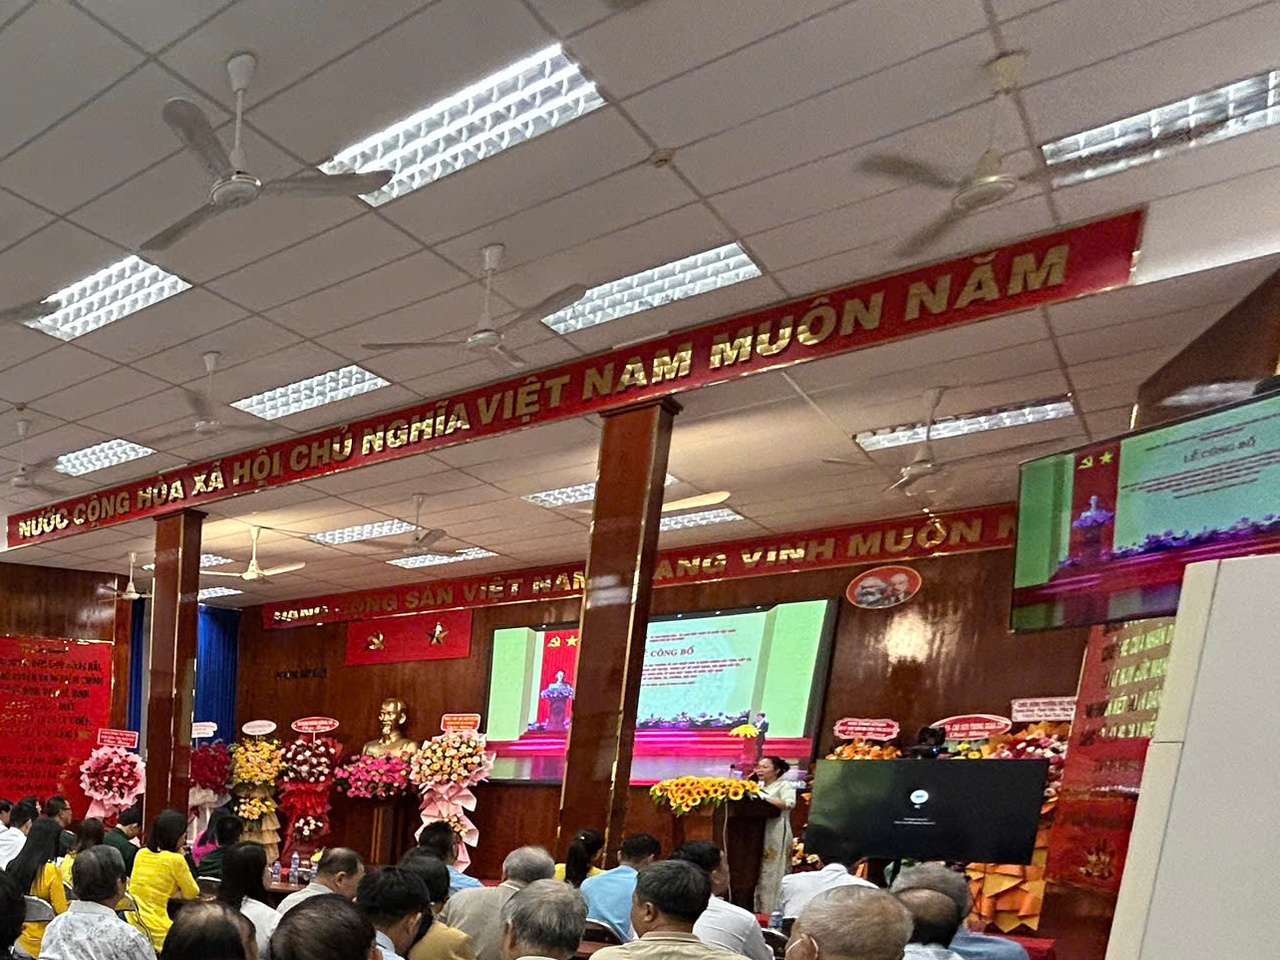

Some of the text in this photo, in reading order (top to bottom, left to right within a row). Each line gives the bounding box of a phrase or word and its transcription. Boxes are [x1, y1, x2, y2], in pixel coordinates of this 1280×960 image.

[19, 245, 1070, 538] NƯỚC CỘNG HÒA XÃ HỘI CHỦ NGHĨA VIỆT NAM MUÔN NĂM
[652, 551, 727, 580] ANG
[741, 538, 836, 569] VINH
